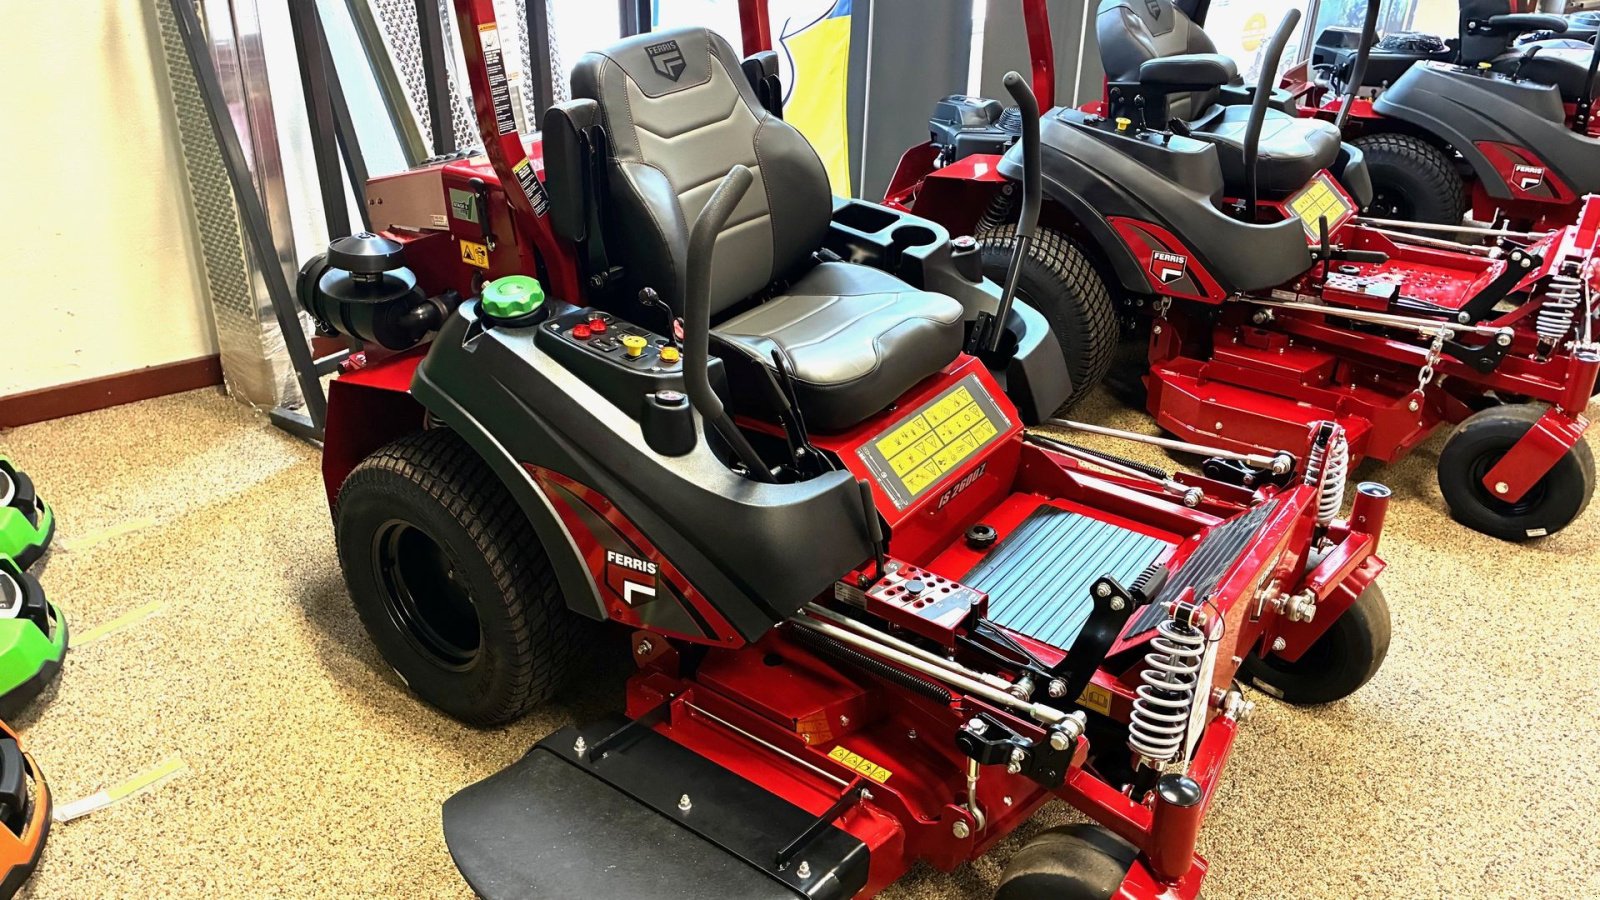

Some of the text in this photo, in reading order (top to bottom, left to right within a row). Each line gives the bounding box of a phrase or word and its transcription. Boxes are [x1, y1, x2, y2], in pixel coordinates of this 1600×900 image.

[647, 42, 677, 55] FERRIS
[1154, 252, 1185, 264] FERRIS
[607, 550, 657, 574] FERRIS
